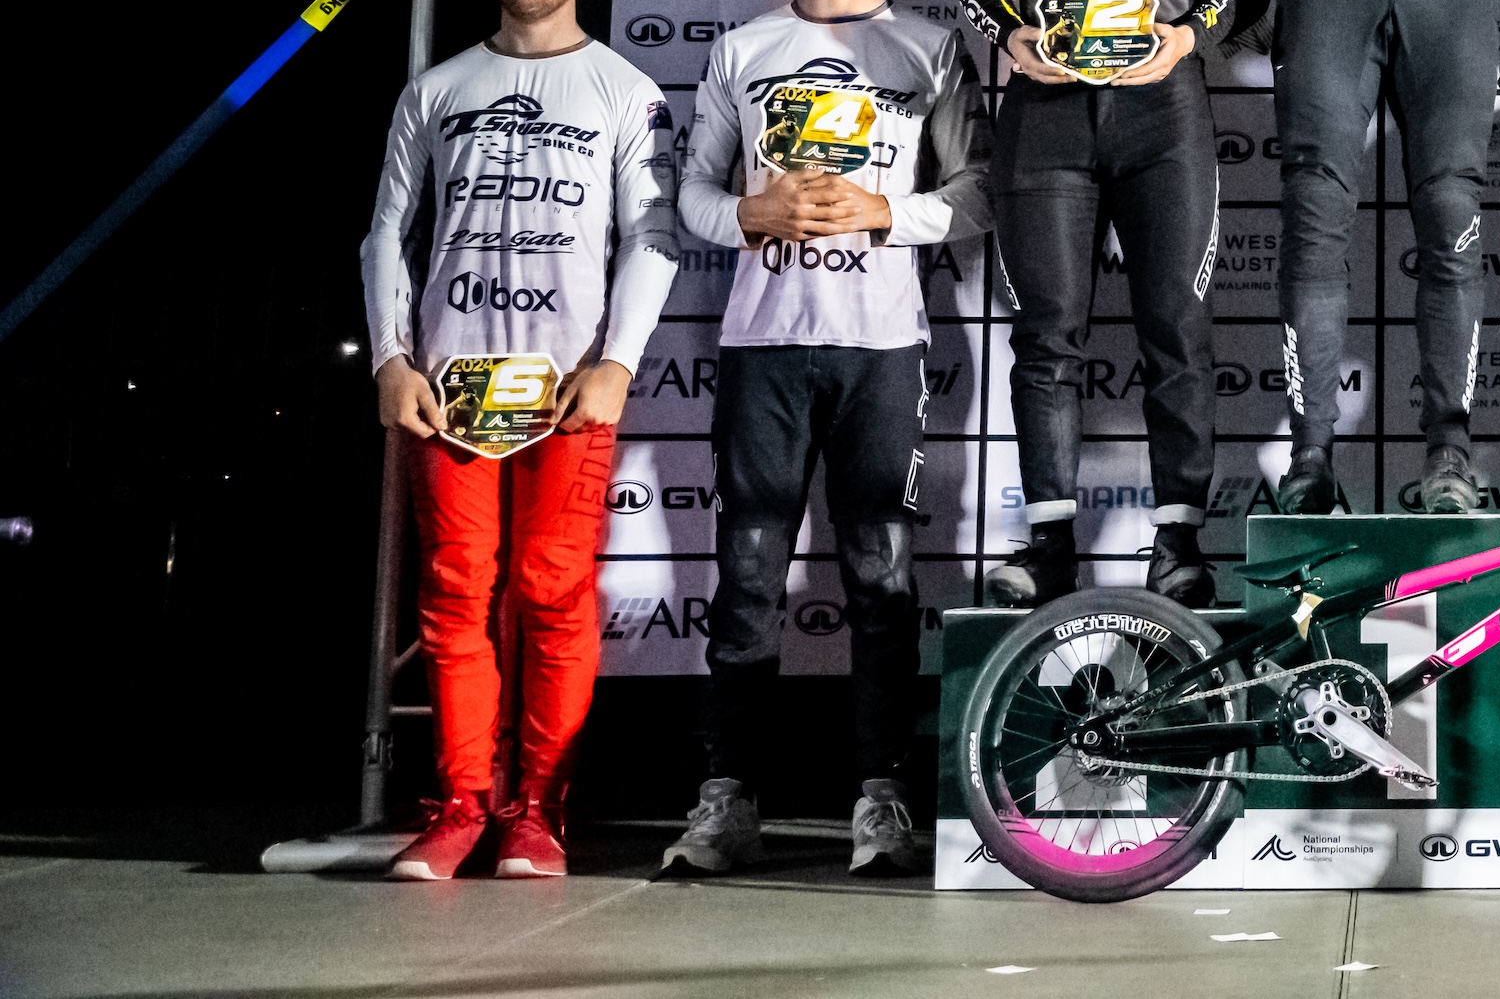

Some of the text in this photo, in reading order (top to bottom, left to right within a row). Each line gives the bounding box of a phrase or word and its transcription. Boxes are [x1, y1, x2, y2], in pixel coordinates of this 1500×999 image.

[683, 21, 748, 43] GW
[775, 87, 817, 103] 2024
[813, 99, 863, 139] 4
[896, 107, 914, 119] CO
[542, 138, 595, 158] BIKE CO
[445, 174, 586, 208] RADIO
[442, 229, 576, 248] Pro Gate
[800, 240, 868, 273] box
[490, 277, 558, 313] box
[1214, 281, 1273, 291] WALKING
[450, 358, 494, 372] 2024
[492, 364, 551, 404] 5
[1079, 358, 1146, 400] RA
[1488, 398, 1496, 409] A
[641, 597, 710, 640] AR
[1360, 592, 1438, 800] 1
[1035, 632, 1149, 811] 2
[970, 731, 979, 770] TIOGA
[1303, 834, 1342, 845] National
[1303, 844, 1374, 856] Championships
